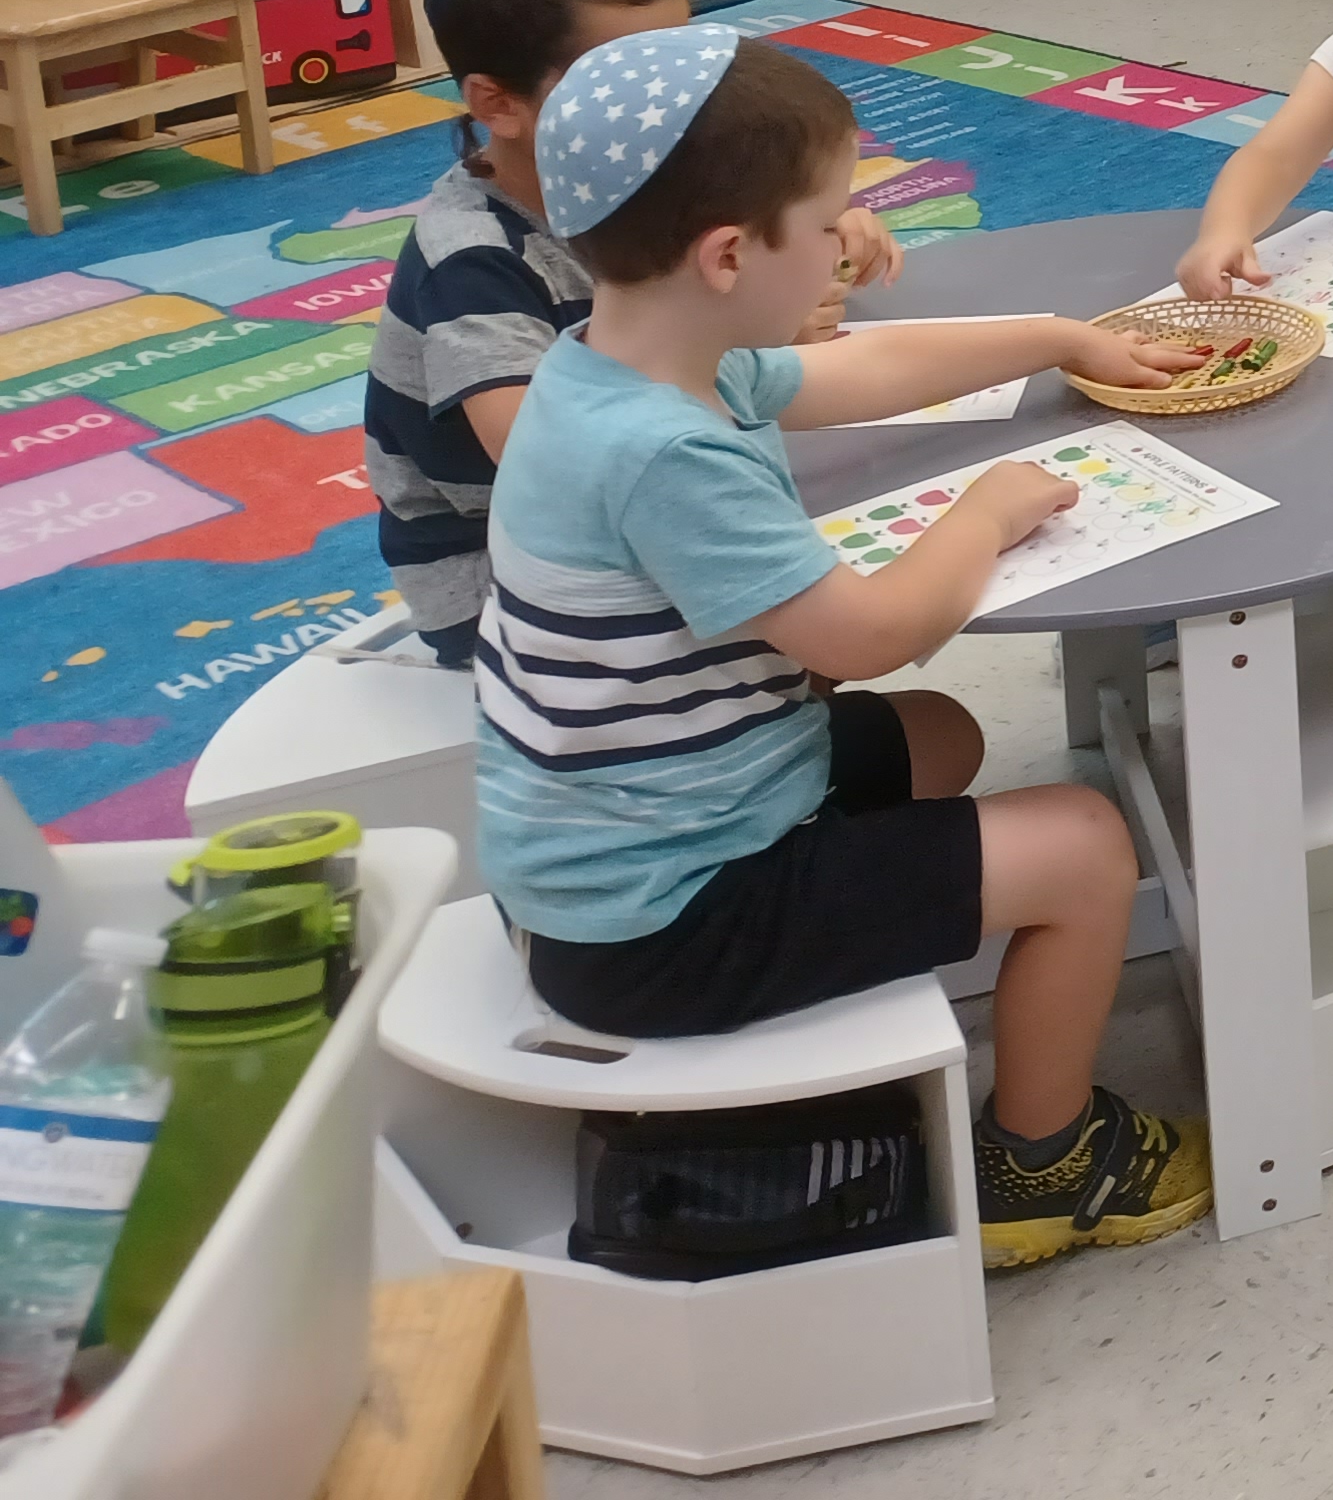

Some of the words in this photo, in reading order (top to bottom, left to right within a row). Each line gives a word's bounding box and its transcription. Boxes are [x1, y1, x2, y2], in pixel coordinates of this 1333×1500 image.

[1073, 74, 1177, 106] K
[1153, 94, 1223, 114] k
[271, 122, 329, 150] F
[863, 175, 935, 201] NORTH
[864, 176, 964, 209] CAROLINA
[0, 320, 273, 409] NEBRASKA
[168, 341, 372, 413] KANSAS
[1142, 451, 1168, 470] APPLE
[1166, 463, 1209, 489] PATTERNS
[155, 606, 374, 700] HAWAII
